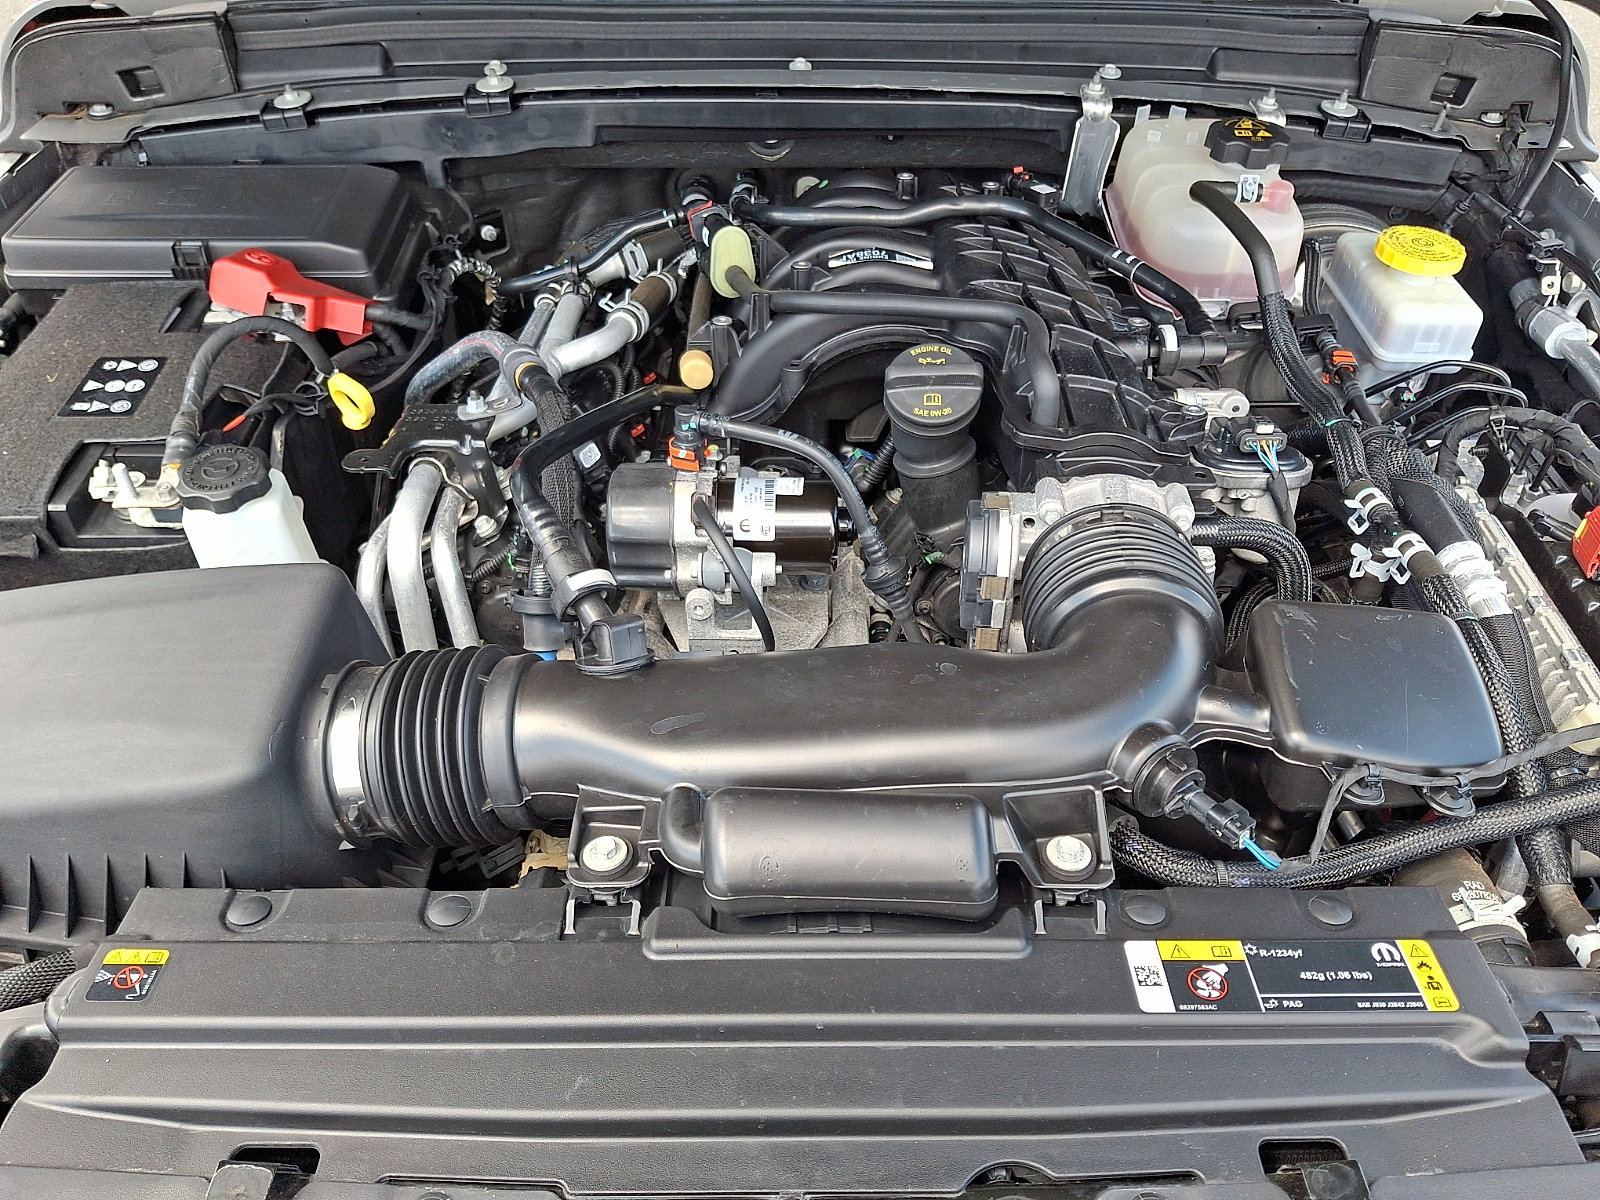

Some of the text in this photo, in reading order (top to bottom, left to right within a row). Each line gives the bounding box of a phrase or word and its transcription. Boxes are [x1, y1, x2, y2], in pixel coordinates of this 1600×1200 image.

[910, 345, 953, 356] ENGINE OIL
[913, 407, 952, 417] SAE 0W-20
[1462, 880, 1485, 890] RAD
[1259, 949, 1303, 959] R-1234yf
[1300, 971, 1325, 981] 482g
[1352, 971, 1373, 981] lbs)
[1282, 1000, 1304, 1008] PAG
